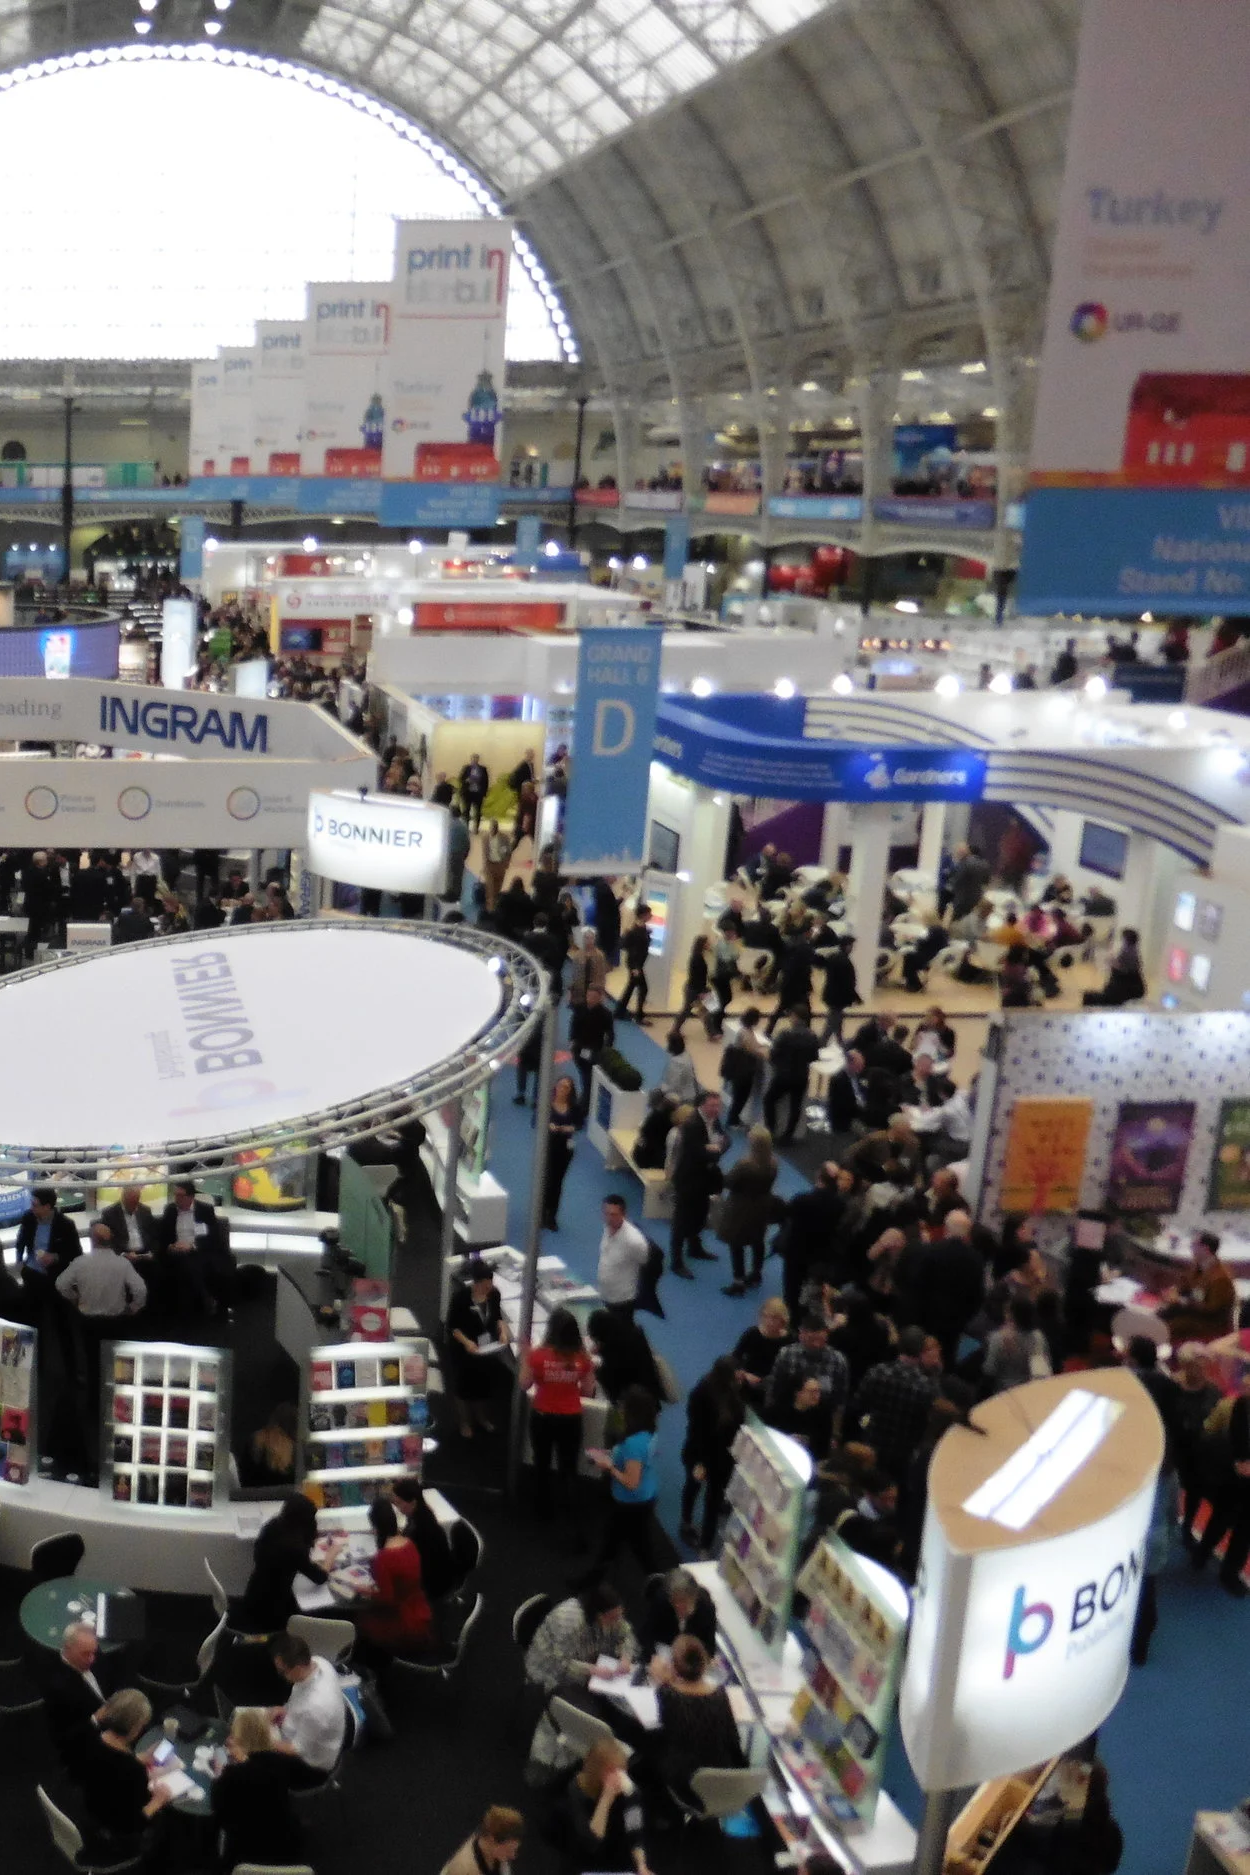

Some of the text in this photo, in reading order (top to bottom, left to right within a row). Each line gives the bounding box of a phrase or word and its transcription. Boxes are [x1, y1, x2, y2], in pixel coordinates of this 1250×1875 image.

[1085, 187, 1223, 234] Turkey
[407, 243, 472, 275] print
[316, 300, 365, 323] print
[261, 331, 302, 351] print
[586, 644, 653, 664] GRAND
[586, 666, 630, 685] HALL
[99, 695, 269, 754] INGRAM
[592, 698, 636, 756] D
[328, 818, 423, 849] BONNIER
[169, 951, 264, 1075] BONNIER
